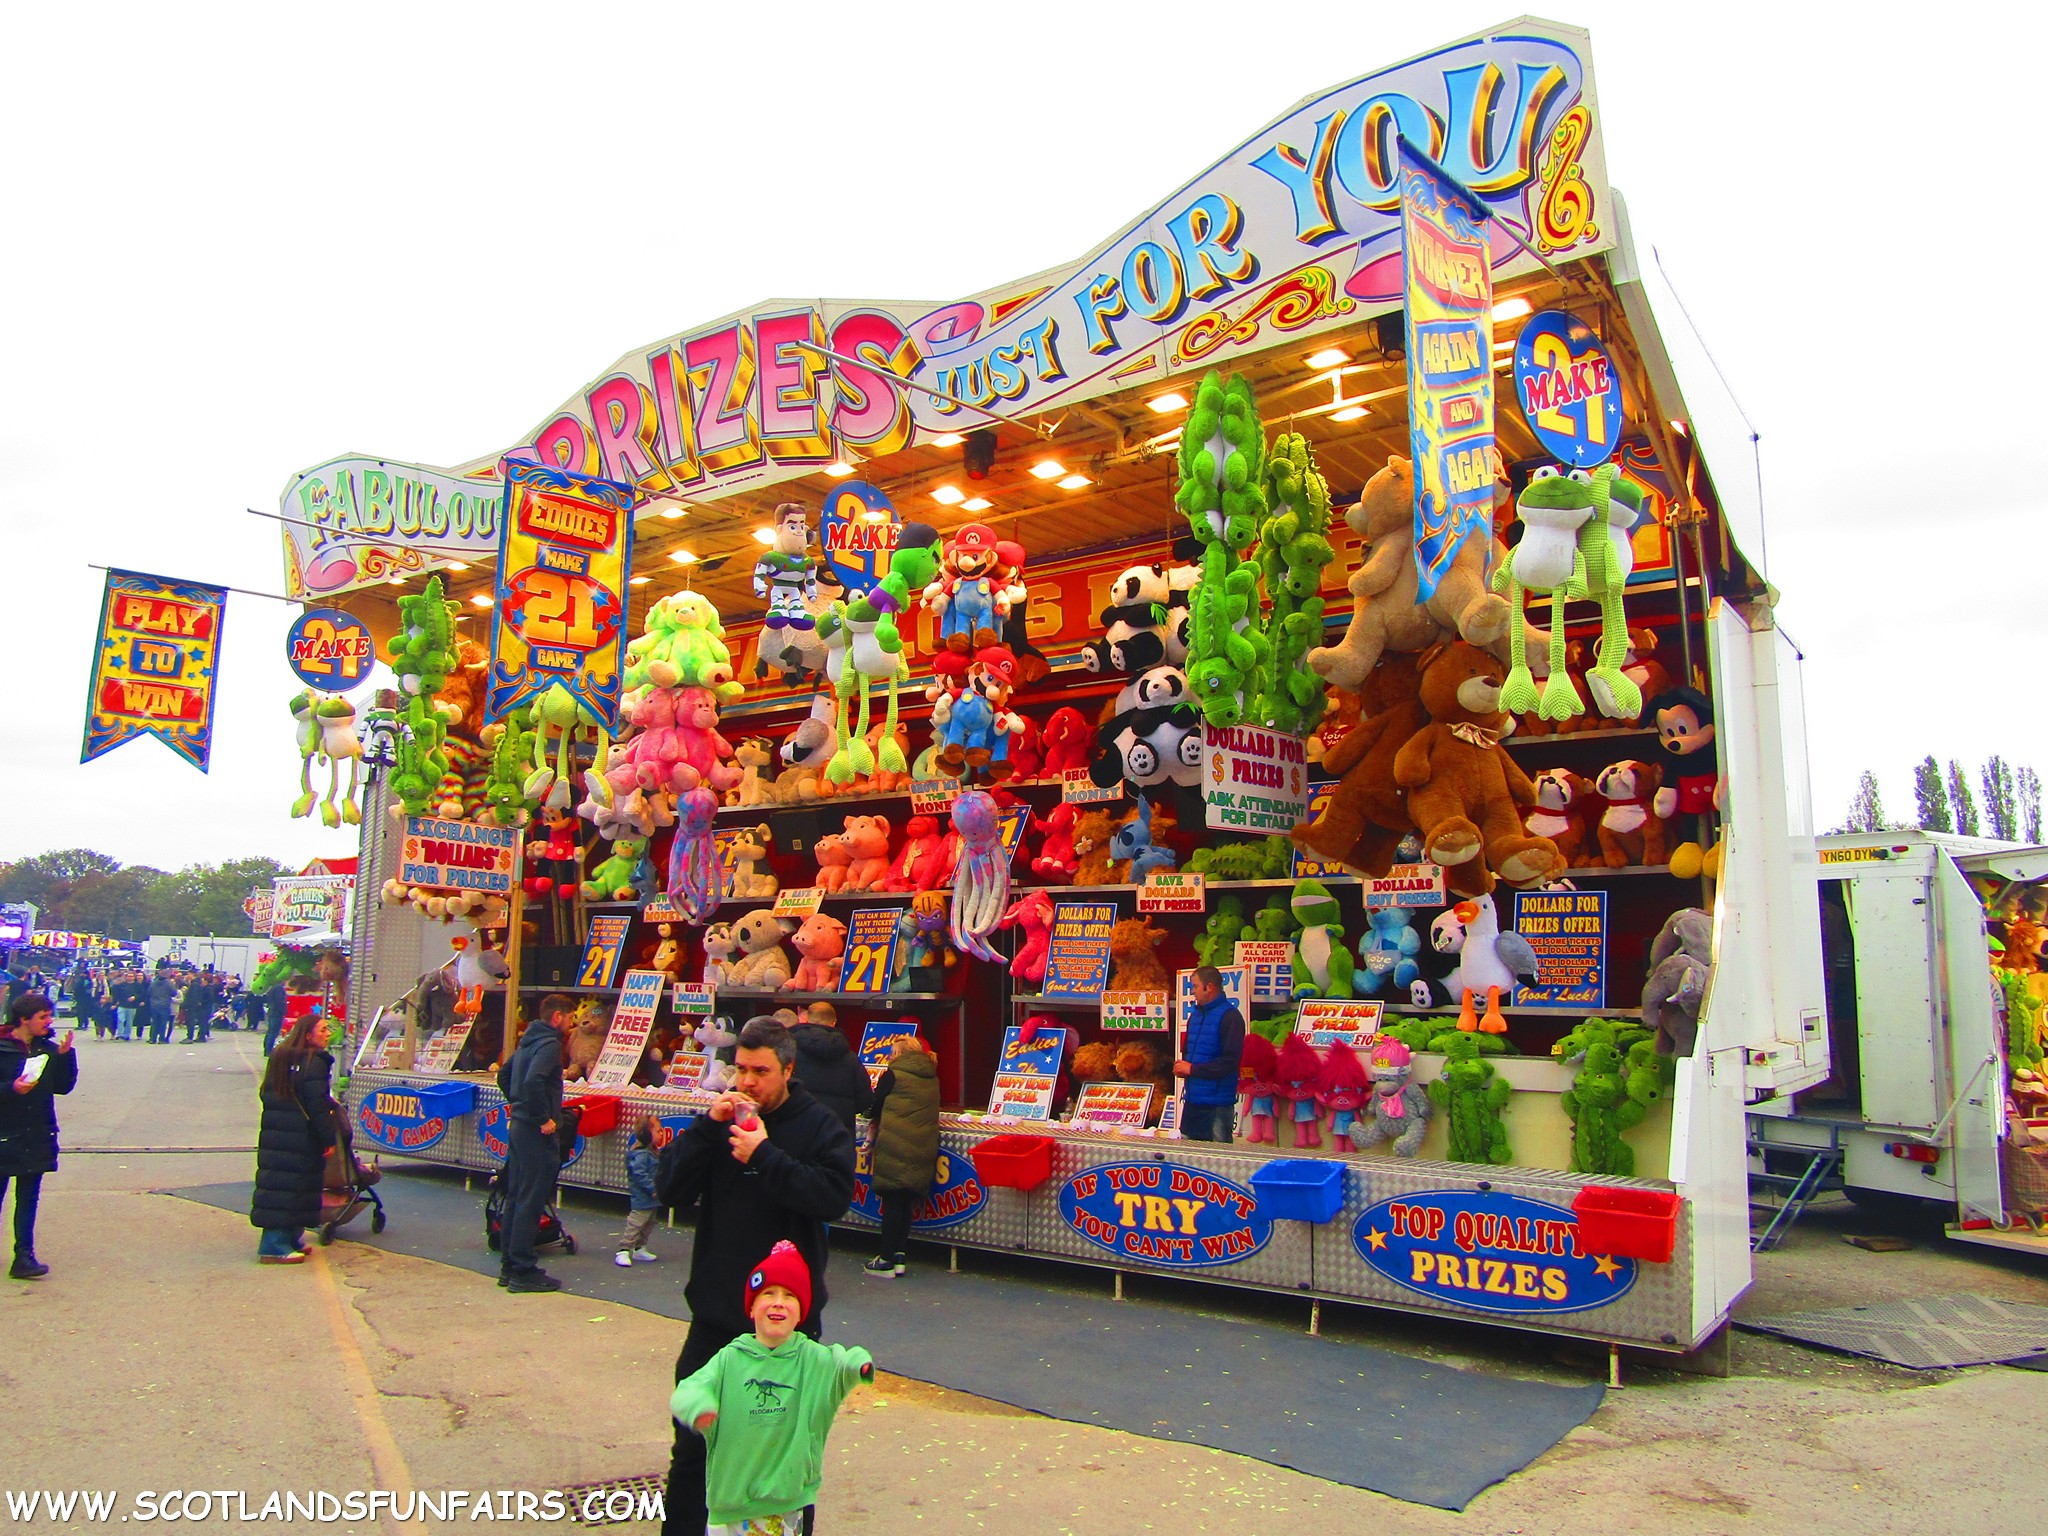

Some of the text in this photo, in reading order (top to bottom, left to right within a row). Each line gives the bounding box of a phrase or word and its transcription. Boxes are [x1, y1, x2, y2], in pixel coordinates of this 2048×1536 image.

[928, 61, 1572, 416] JUST FOR YOU
[1411, 229, 1489, 302] WINNER
[1422, 331, 1481, 375] AGAIN
[1524, 356, 1610, 416] MAKE
[1533, 331, 1608, 446] 21
[531, 306, 924, 503] PRIZES
[1449, 400, 1474, 423] AND
[1446, 444, 1495, 495] AGAI
[528, 498, 608, 547] EDDIES
[826, 522, 901, 552] MAKE
[833, 491, 899, 580] 21
[544, 551, 585, 573] MAKE
[123, 599, 199, 636] PLAY
[523, 571, 601, 648] 21
[292, 637, 370, 661] MAKE
[300, 619, 363, 678] 21
[138, 643, 176, 674] TO
[536, 650, 578, 669] GAME
[122, 684, 185, 717] WIN
[1207, 725, 1304, 765] DOLLARS FOR
[1232, 758, 1284, 789] PRIZES
[911, 782, 938, 794] SHOW
[1065, 787, 1120, 802] MONEY
[926, 792, 946, 801] THE
[1207, 791, 1306, 816] ASK ATTENDANT
[1221, 809, 1246, 825] FOR
[407, 817, 513, 848] EXCHANGE
[1823, 851, 1851, 862] YN60
[402, 864, 509, 891] FOR PRIZES
[1296, 863, 1319, 876] TO
[1156, 876, 1183, 886] SAVE
[1373, 879, 1433, 892] DOLLARS
[291, 889, 325, 904] GAMES
[1145, 887, 1195, 898] DOLLARS
[1367, 892, 1442, 905] BUY PRIZES
[256, 898, 272, 910] WIN
[1140, 900, 1201, 911] BUY PRIZES
[1521, 896, 1599, 913] DOLLARS FOR
[256, 911, 272, 921] BIG
[287, 906, 301, 921] TO
[302, 905, 327, 921] PLAY
[1058, 907, 1111, 920] DOLLARS FOR
[1055, 924, 1110, 937] PRIZES OFFER
[1519, 917, 1601, 933] PRIZES OFFER
[580, 945, 617, 987] 21
[844, 944, 890, 992] 21
[1560, 958, 1596, 966] DOLLARS
[1549, 968, 1566, 976] CAN
[626, 974, 661, 990] HAPPY
[685, 984, 702, 993] SAVE
[1046, 980, 1102, 993] Good Luck!
[1552, 977, 1582, 985] PRIZES
[622, 993, 656, 1008] HOUR
[678, 994, 708, 1002] DOLLARS
[1103, 993, 1165, 1006] SHOW ME
[1517, 986, 1599, 1005] Good Luck!
[1121, 1006, 1147, 1016] THE
[1303, 1004, 1378, 1018] HAPPY HOUR
[612, 1015, 651, 1032] FREE
[1104, 1017, 1165, 1030] MONEY
[1313, 1018, 1359, 1031] SPECIAL
[610, 1033, 644, 1047] TICKETS
[1354, 1034, 1374, 1046] £10
[997, 1076, 1053, 1090] HAPPY HOUR
[1003, 1090, 1038, 1103] SPECIAL
[1085, 1086, 1148, 1099] HAPPY HOUR
[992, 1103, 1002, 1114] 8
[485, 1109, 499, 1125] IF
[1079, 1111, 1091, 1120] 45
[1123, 1112, 1141, 1123] £20
[360, 1106, 383, 1136] FUN
[402, 1117, 444, 1147] GAMES
[484, 1131, 508, 1158] YOU
[1072, 1167, 1256, 1219] IF YOU DON'T
[1115, 1192, 1205, 1235] TRY
[1073, 1206, 1257, 1260] YOU CAN'T WIN
[1389, 1203, 1587, 1259] TOP QUALITY
[1410, 1250, 1569, 1302] PRIZES
